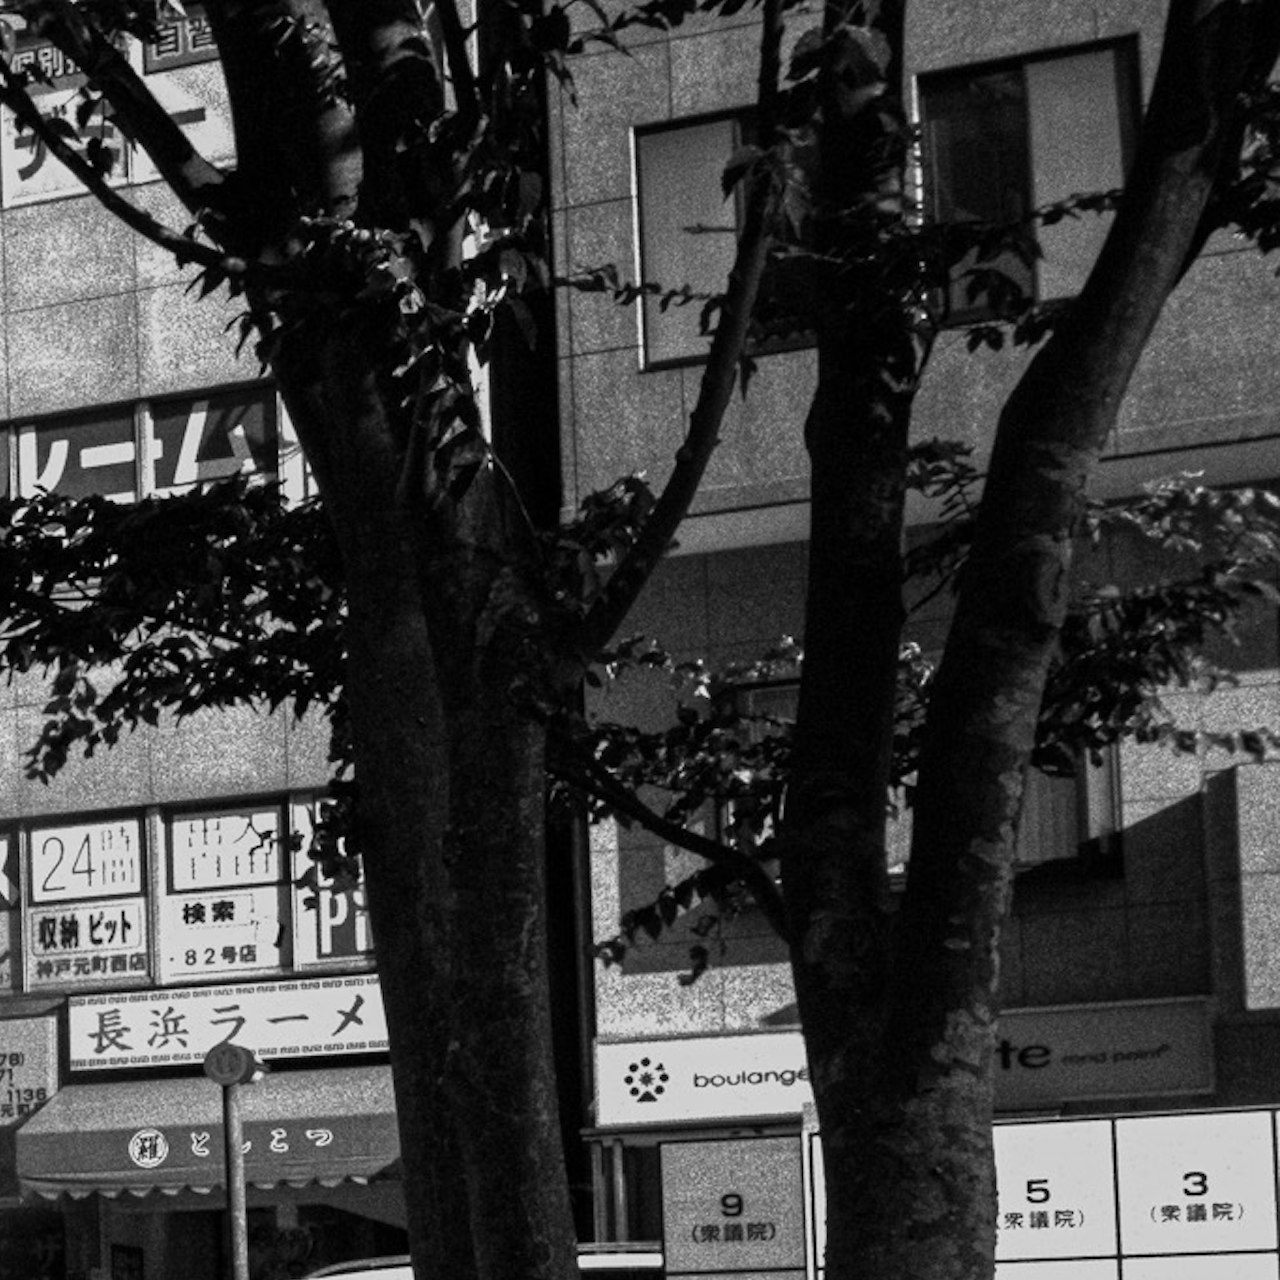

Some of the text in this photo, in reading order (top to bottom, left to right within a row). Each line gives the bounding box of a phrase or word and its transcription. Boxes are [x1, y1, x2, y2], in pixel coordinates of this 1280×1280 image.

[41, 833, 96, 893] 24
[182, 900, 236, 925] 検索
[7, 1088, 47, 1103] 1136
[191, 1128, 334, 1157] とこつ
[1025, 1178, 1052, 1204] 5
[1182, 1171, 1210, 1197] 3
[720, 1193, 744, 1217] 9
[1150, 1202, 1244, 1223] (衆議院)
[692, 1222, 777, 1244] (衆議院)
